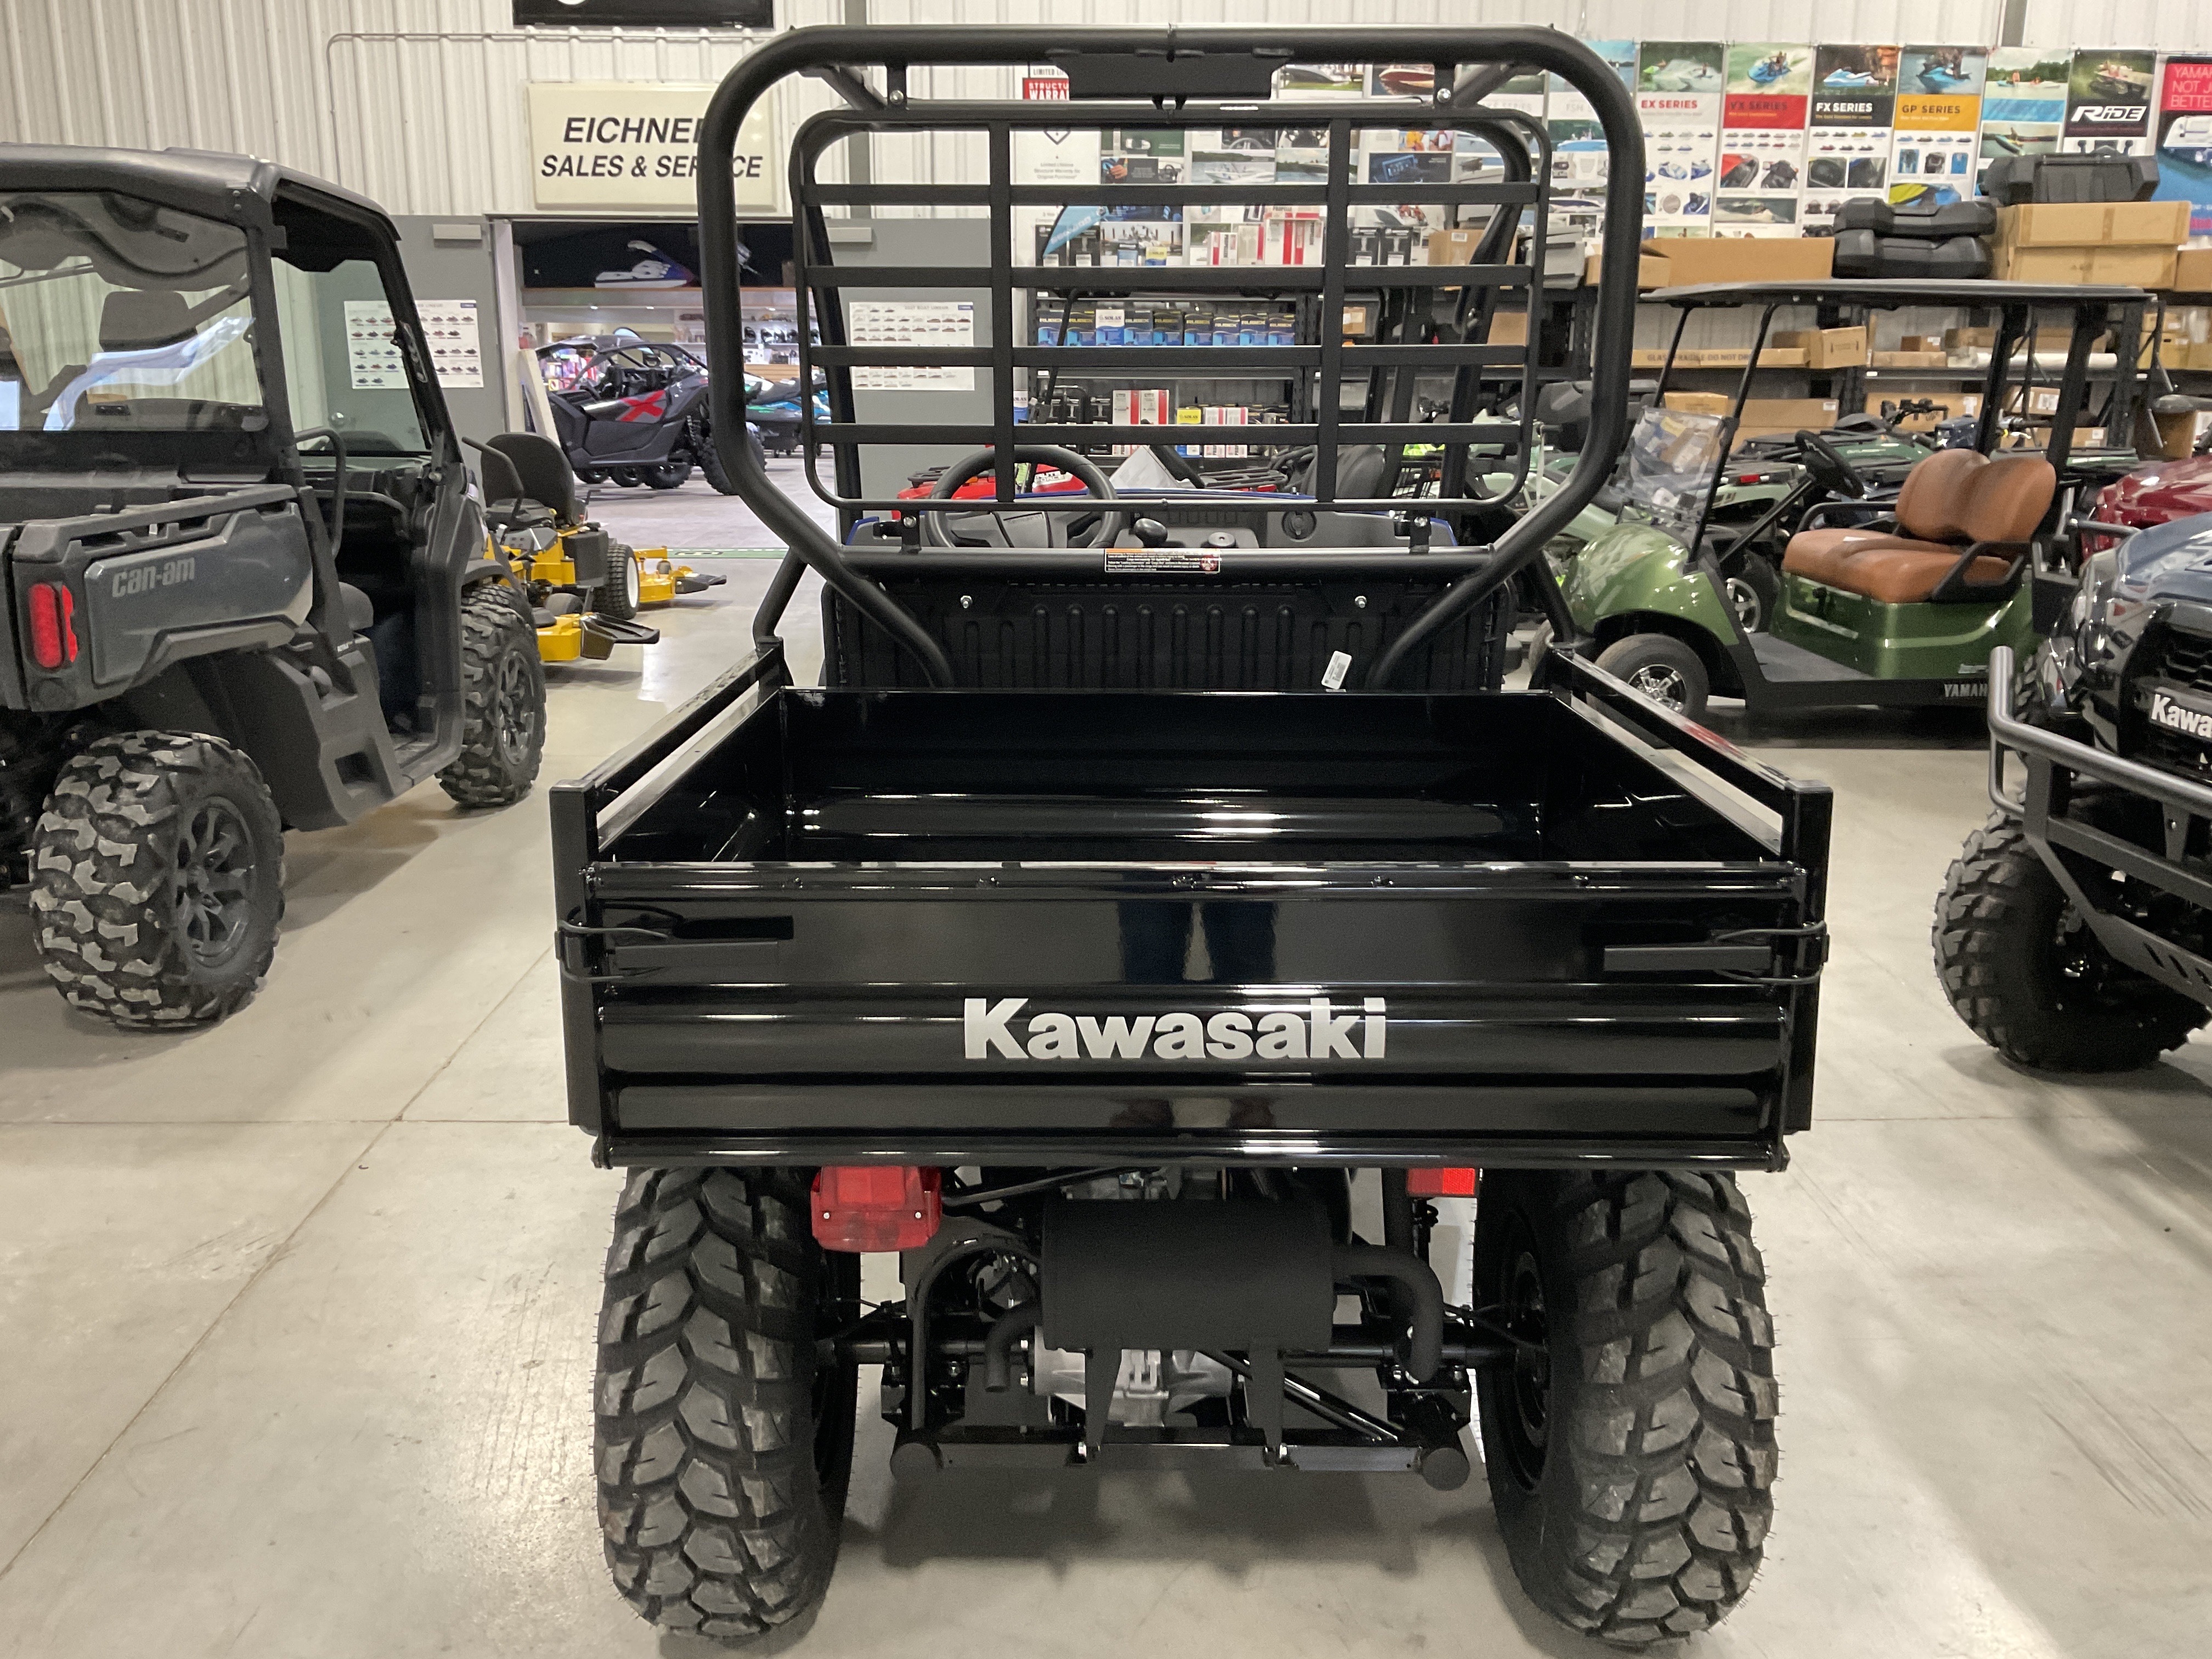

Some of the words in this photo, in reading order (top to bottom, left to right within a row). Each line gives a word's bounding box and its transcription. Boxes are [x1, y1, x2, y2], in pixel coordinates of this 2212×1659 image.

[2172, 80, 2200, 93] NOT
[2203, 81, 2212, 94] J
[1641, 100, 1656, 109] EX
[1658, 100, 1697, 109] SERIES
[1816, 102, 1831, 112] FX
[1833, 102, 1873, 112] SERIES
[1902, 105, 1917, 113] GP
[1922, 105, 1960, 114] SERIES
[541, 155, 623, 178] SALES
[631, 156, 647, 178] &
[655, 155, 763, 178] SERCE
[1944, 684, 1988, 697] YAMAH
[2151, 693, 2212, 738] Kawa
[964, 997, 1386, 1059] Kawasaki
